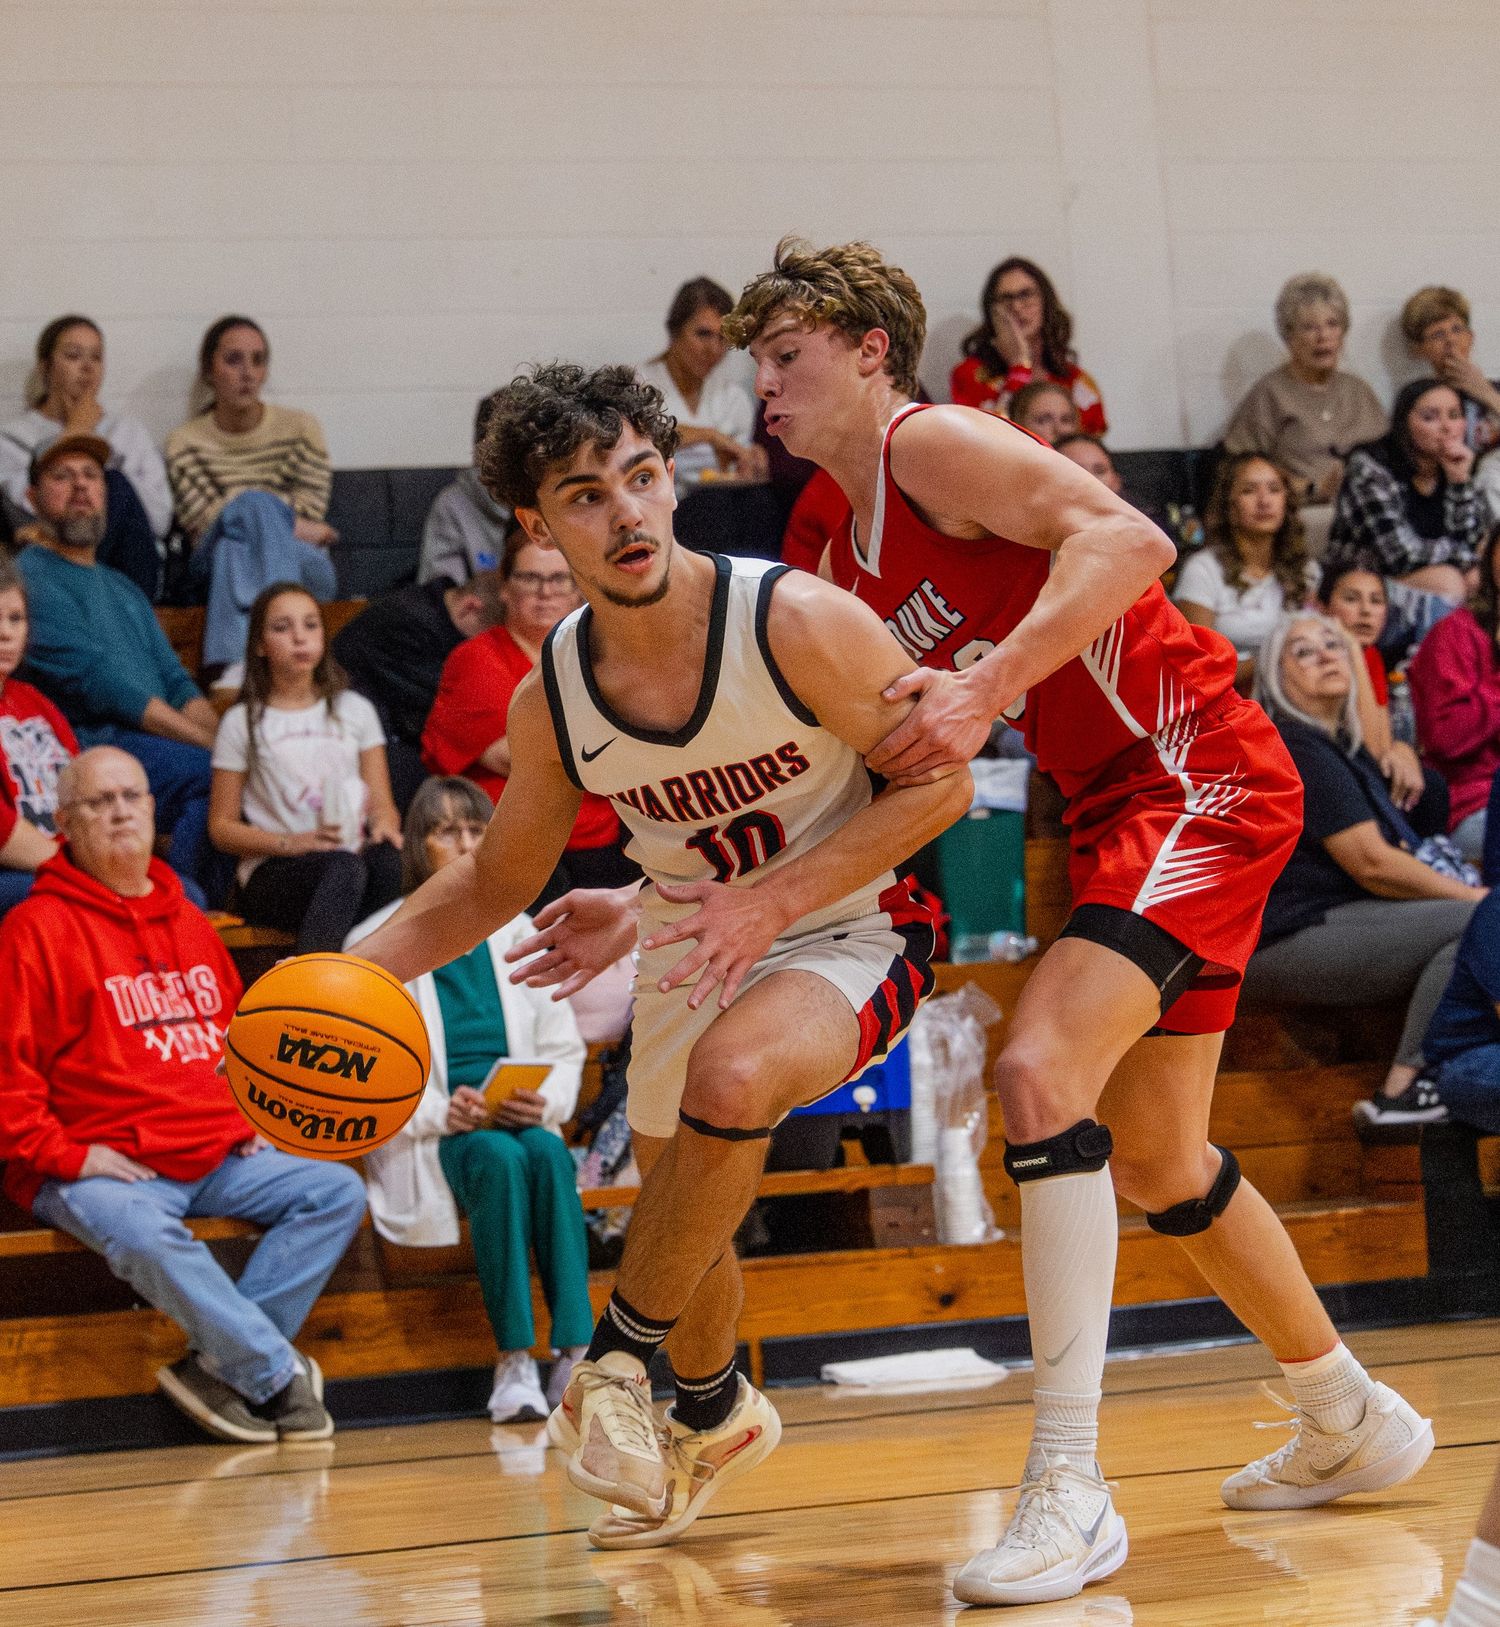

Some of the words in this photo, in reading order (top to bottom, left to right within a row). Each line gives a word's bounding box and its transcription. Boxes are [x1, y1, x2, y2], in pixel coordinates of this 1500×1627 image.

[606, 741, 811, 823] WARRIORS
[685, 809, 787, 883] 10
[284, 1023, 308, 1034] BALL
[309, 1030, 338, 1042] GAME
[341, 1038, 381, 1053] OFFICIAL
[276, 1032, 378, 1083] NCAA
[248, 1081, 377, 1142] Wilson
